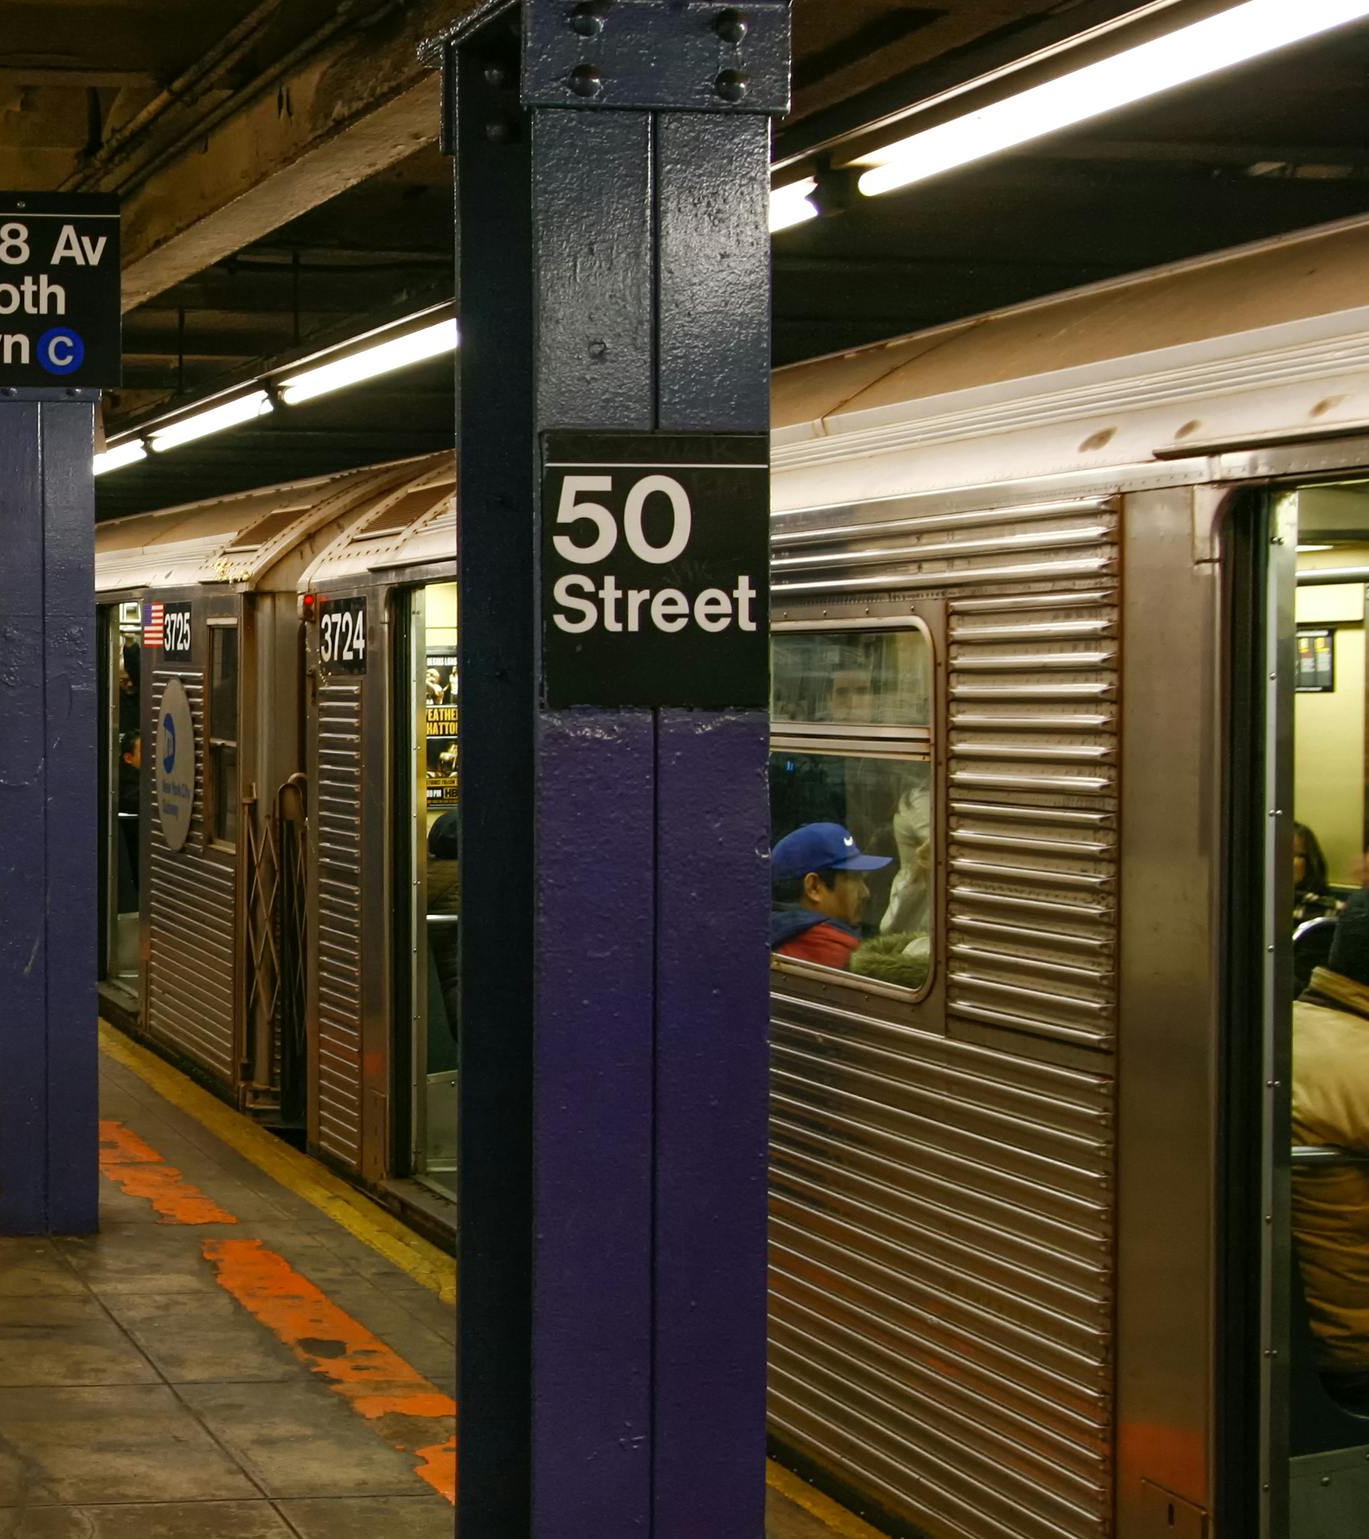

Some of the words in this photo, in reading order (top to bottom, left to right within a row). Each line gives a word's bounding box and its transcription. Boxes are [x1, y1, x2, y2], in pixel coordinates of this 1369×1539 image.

[51, 225, 107, 267] Av
[48, 337, 74, 366] C
[553, 475, 691, 564] 50
[553, 574, 756, 633] Street
[164, 613, 190, 652] 3725
[321, 611, 364, 662] 3724
[426, 708, 458, 721] EATHE
[426, 722, 458, 735] HATTO
[445, 788, 458, 798] HB
